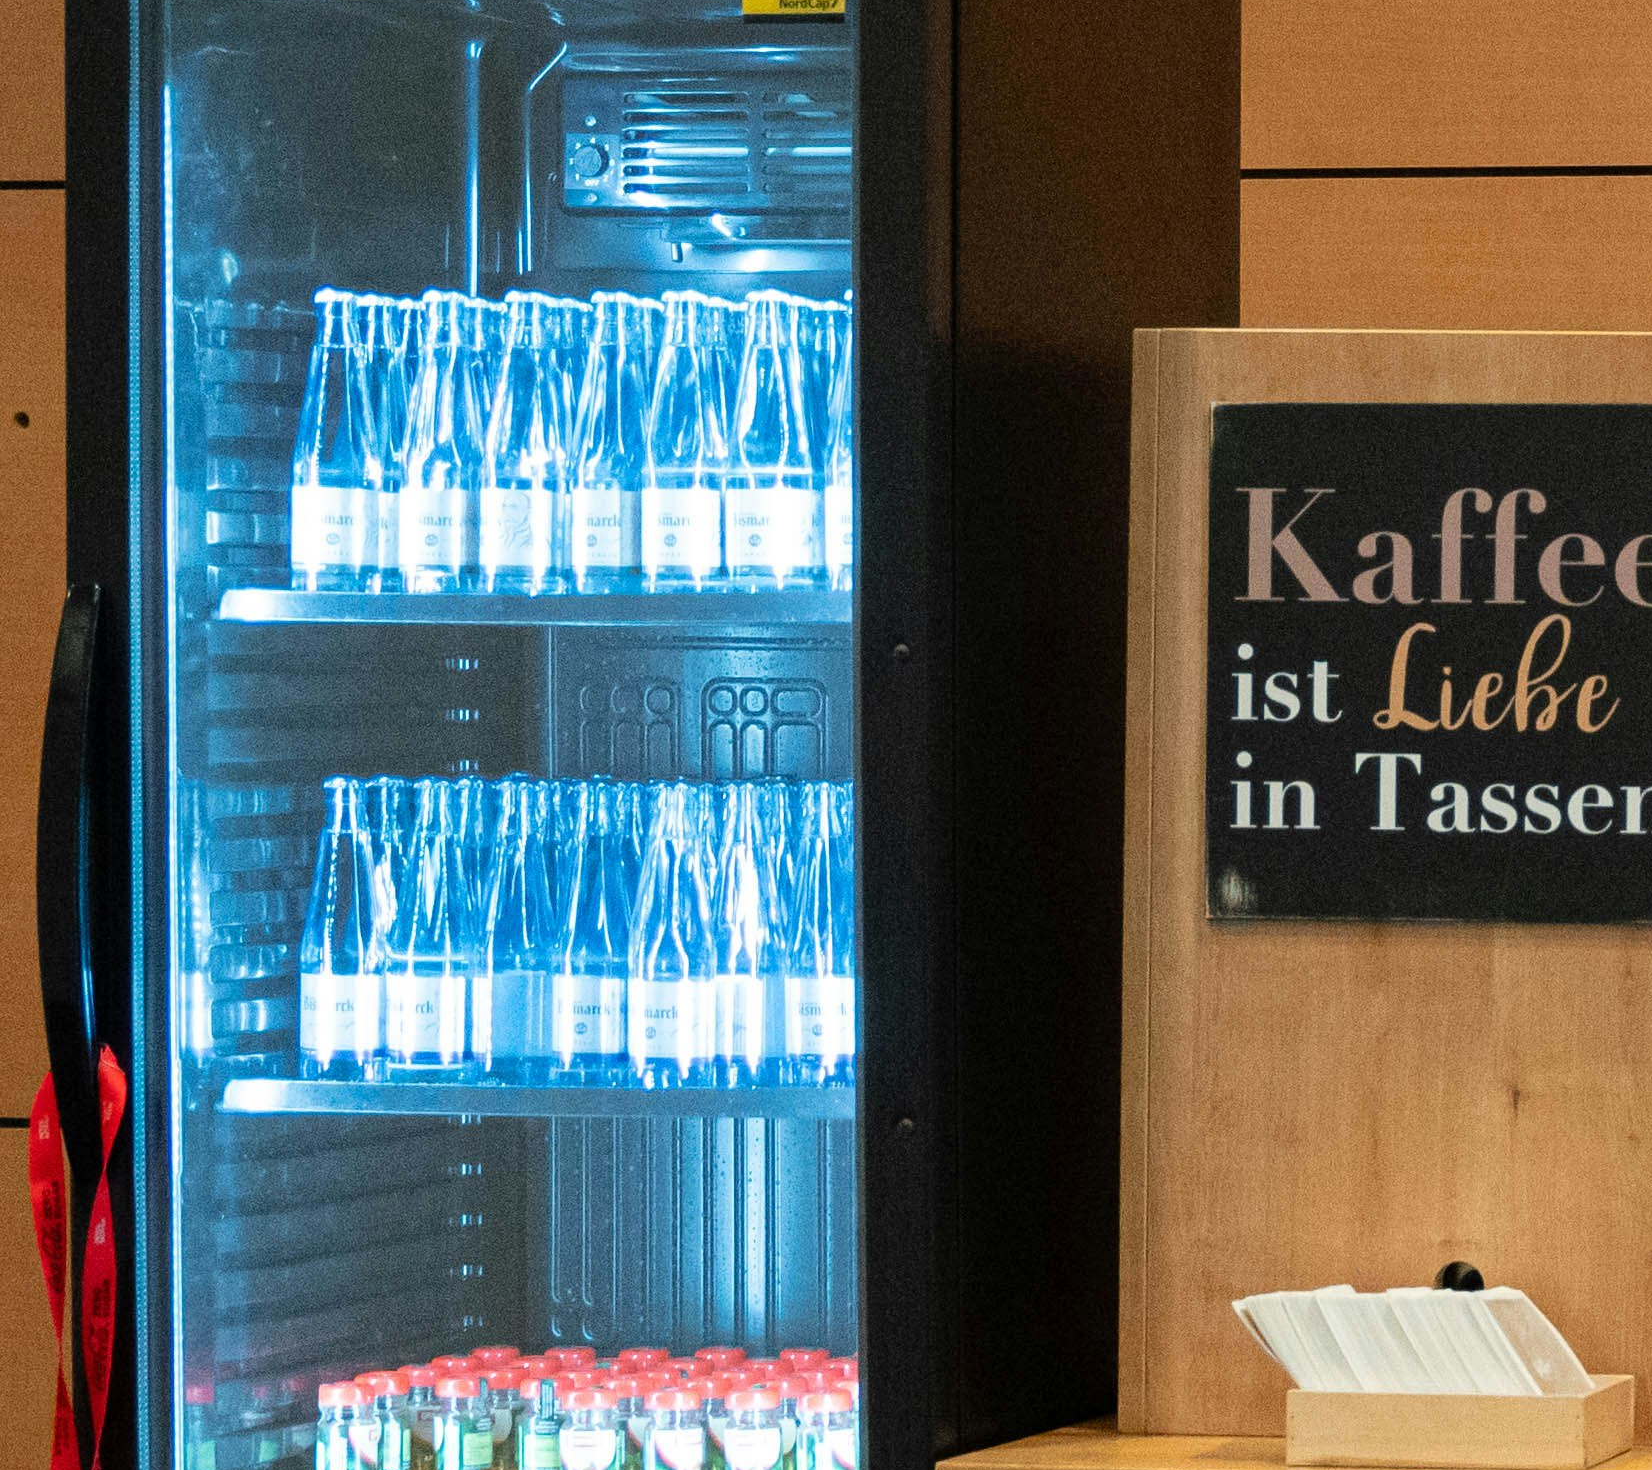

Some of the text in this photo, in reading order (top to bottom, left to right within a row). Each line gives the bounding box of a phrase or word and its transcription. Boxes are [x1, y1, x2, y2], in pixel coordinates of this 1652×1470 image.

[1230, 612, 1621, 734] ist Liebe
[1229, 750, 1322, 831] in
